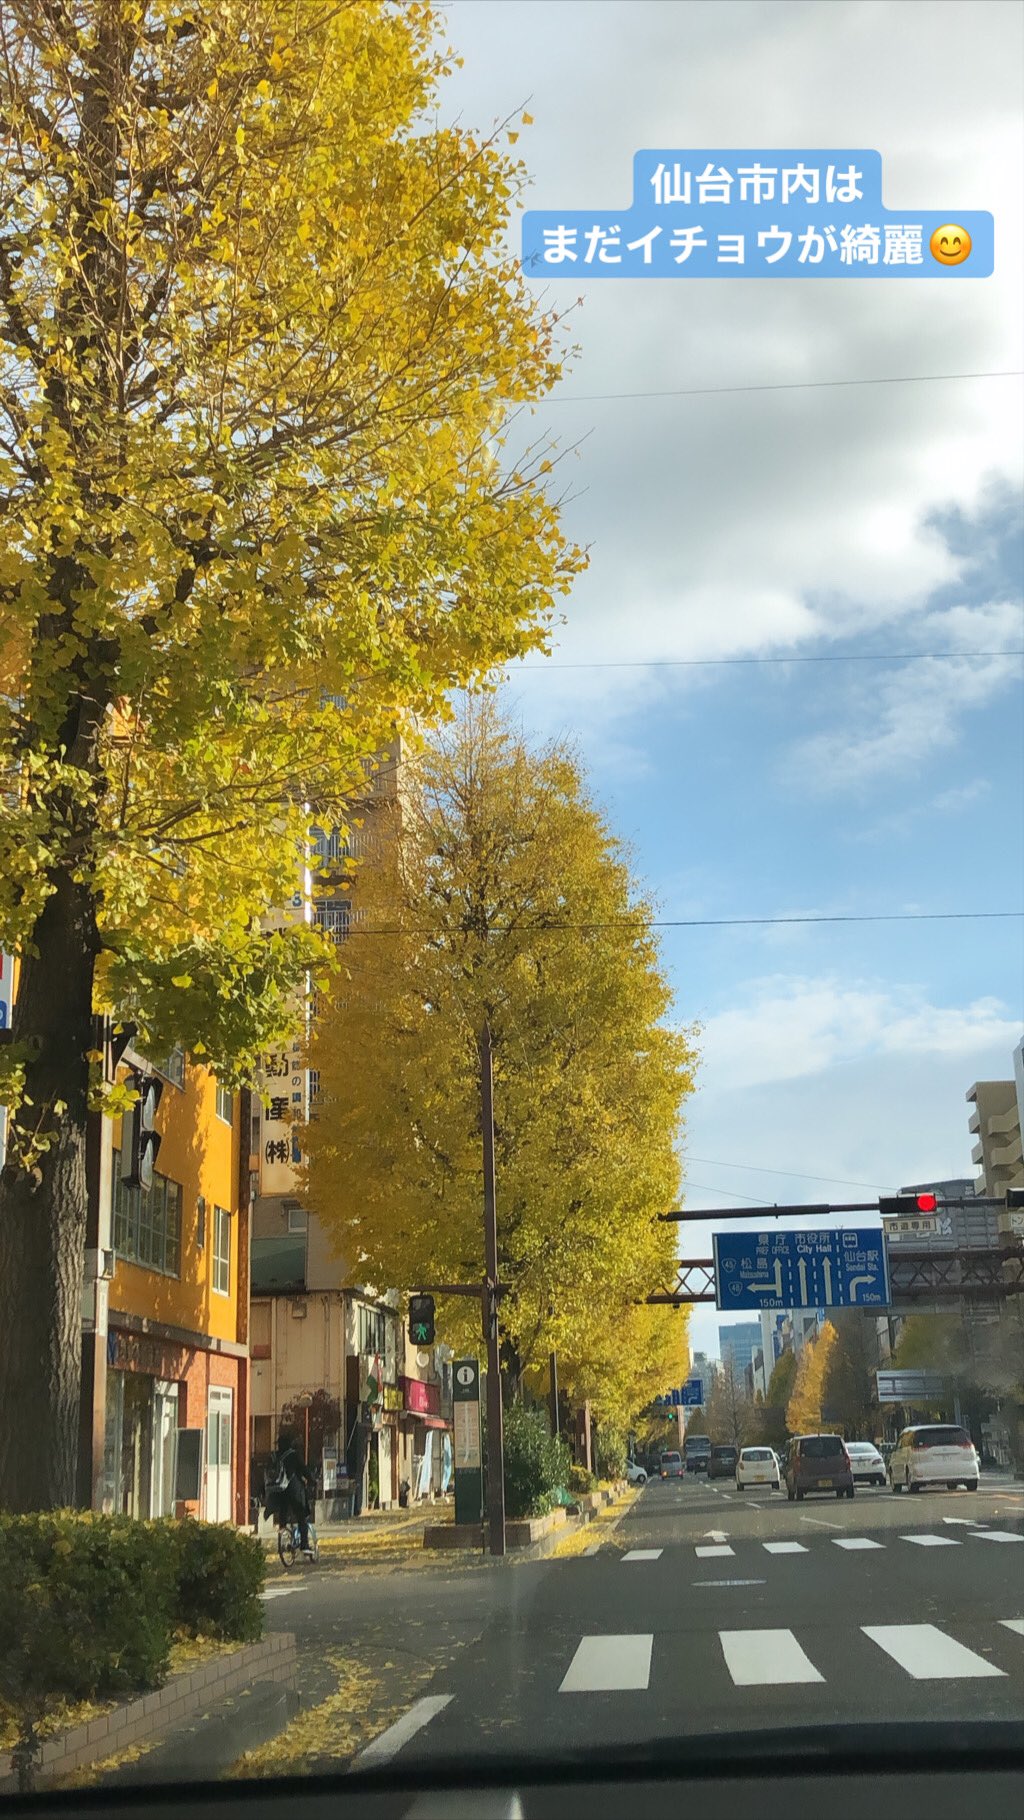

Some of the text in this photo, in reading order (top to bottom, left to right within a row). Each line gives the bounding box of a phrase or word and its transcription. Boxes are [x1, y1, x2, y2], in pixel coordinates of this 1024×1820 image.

[758, 1233, 785, 1246] 県庁
[795, 1232, 830, 1244] 市役所
[797, 1244, 832, 1255] City Hall
[844, 1250, 879, 1262] 仙台駅
[740, 1257, 768, 1269] 松島
[846, 1262, 866, 1272] Sendai
[760, 1298, 783, 1307] 150m
[863, 1293, 881, 1302] 150m
